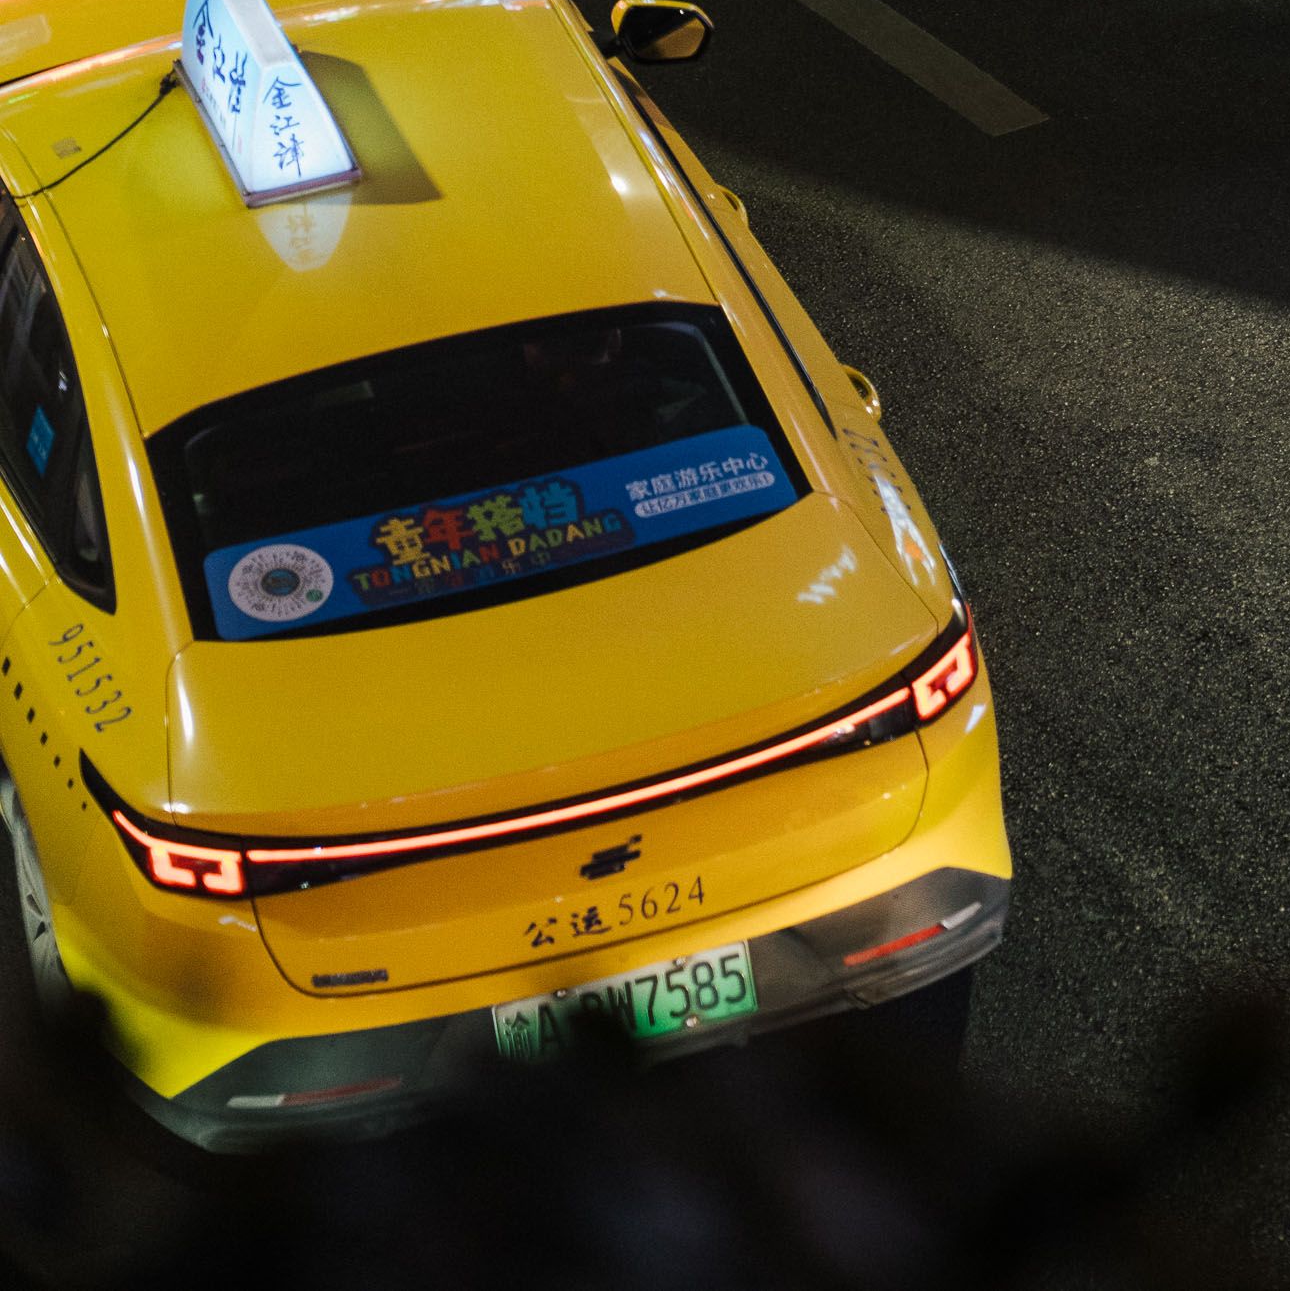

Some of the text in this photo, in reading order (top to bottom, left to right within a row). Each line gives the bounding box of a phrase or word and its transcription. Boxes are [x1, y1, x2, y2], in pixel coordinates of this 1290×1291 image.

[625, 451, 769, 502] 家庭游乐中心
[354, 545, 500, 591] TONGNIAN
[509, 513, 622, 559] DADANG
[378, 480, 581, 565] 童年搭档
[48, 623, 133, 734] 951532
